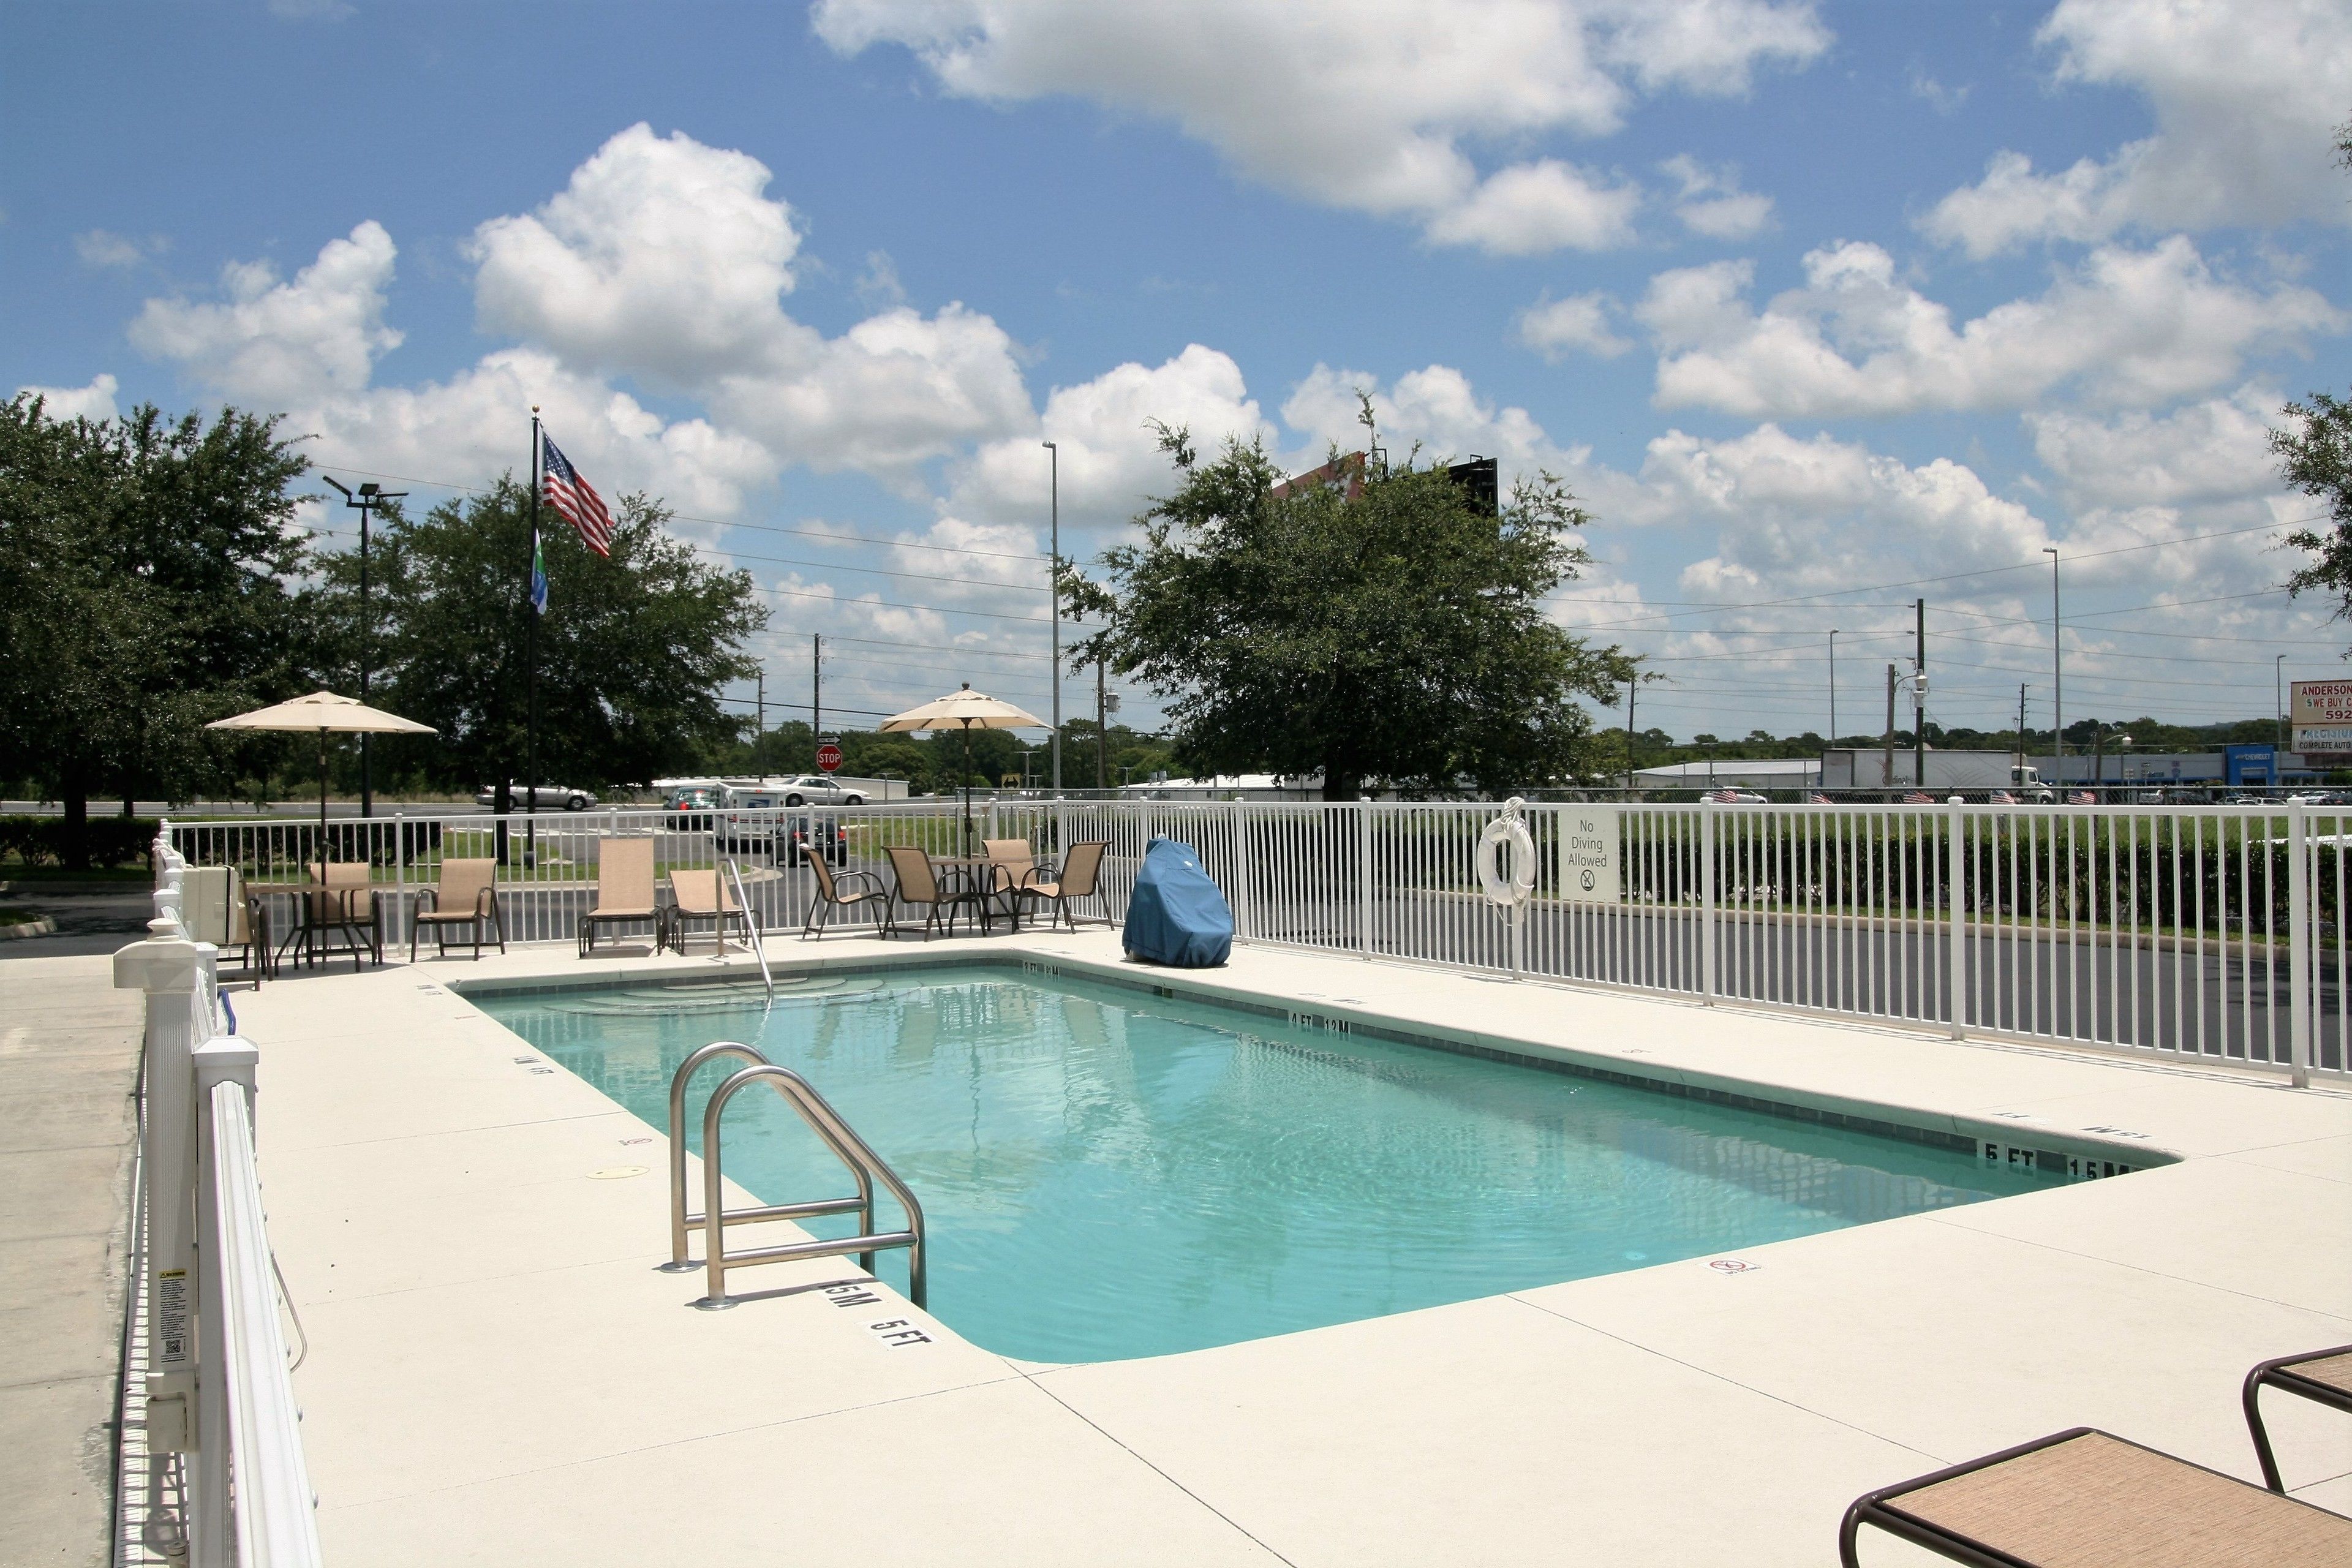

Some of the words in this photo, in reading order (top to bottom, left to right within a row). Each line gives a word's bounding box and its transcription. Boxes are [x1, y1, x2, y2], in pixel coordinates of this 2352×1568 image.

[2301, 685, 2352, 696] ANDERSON
[2328, 698, 2342, 707] BUY
[819, 753, 840, 763] STOP
[1580, 820, 1594, 833] No
[1572, 836, 1603, 853] Diving
[1568, 853, 1607, 867] Allowed
[1301, 1014, 1311, 1026] FT
[1985, 1143, 1998, 1160] 5
[2008, 1147, 2034, 1167] FT
[870, 1319, 910, 1330] 5
[881, 1329, 933, 1347] FT
